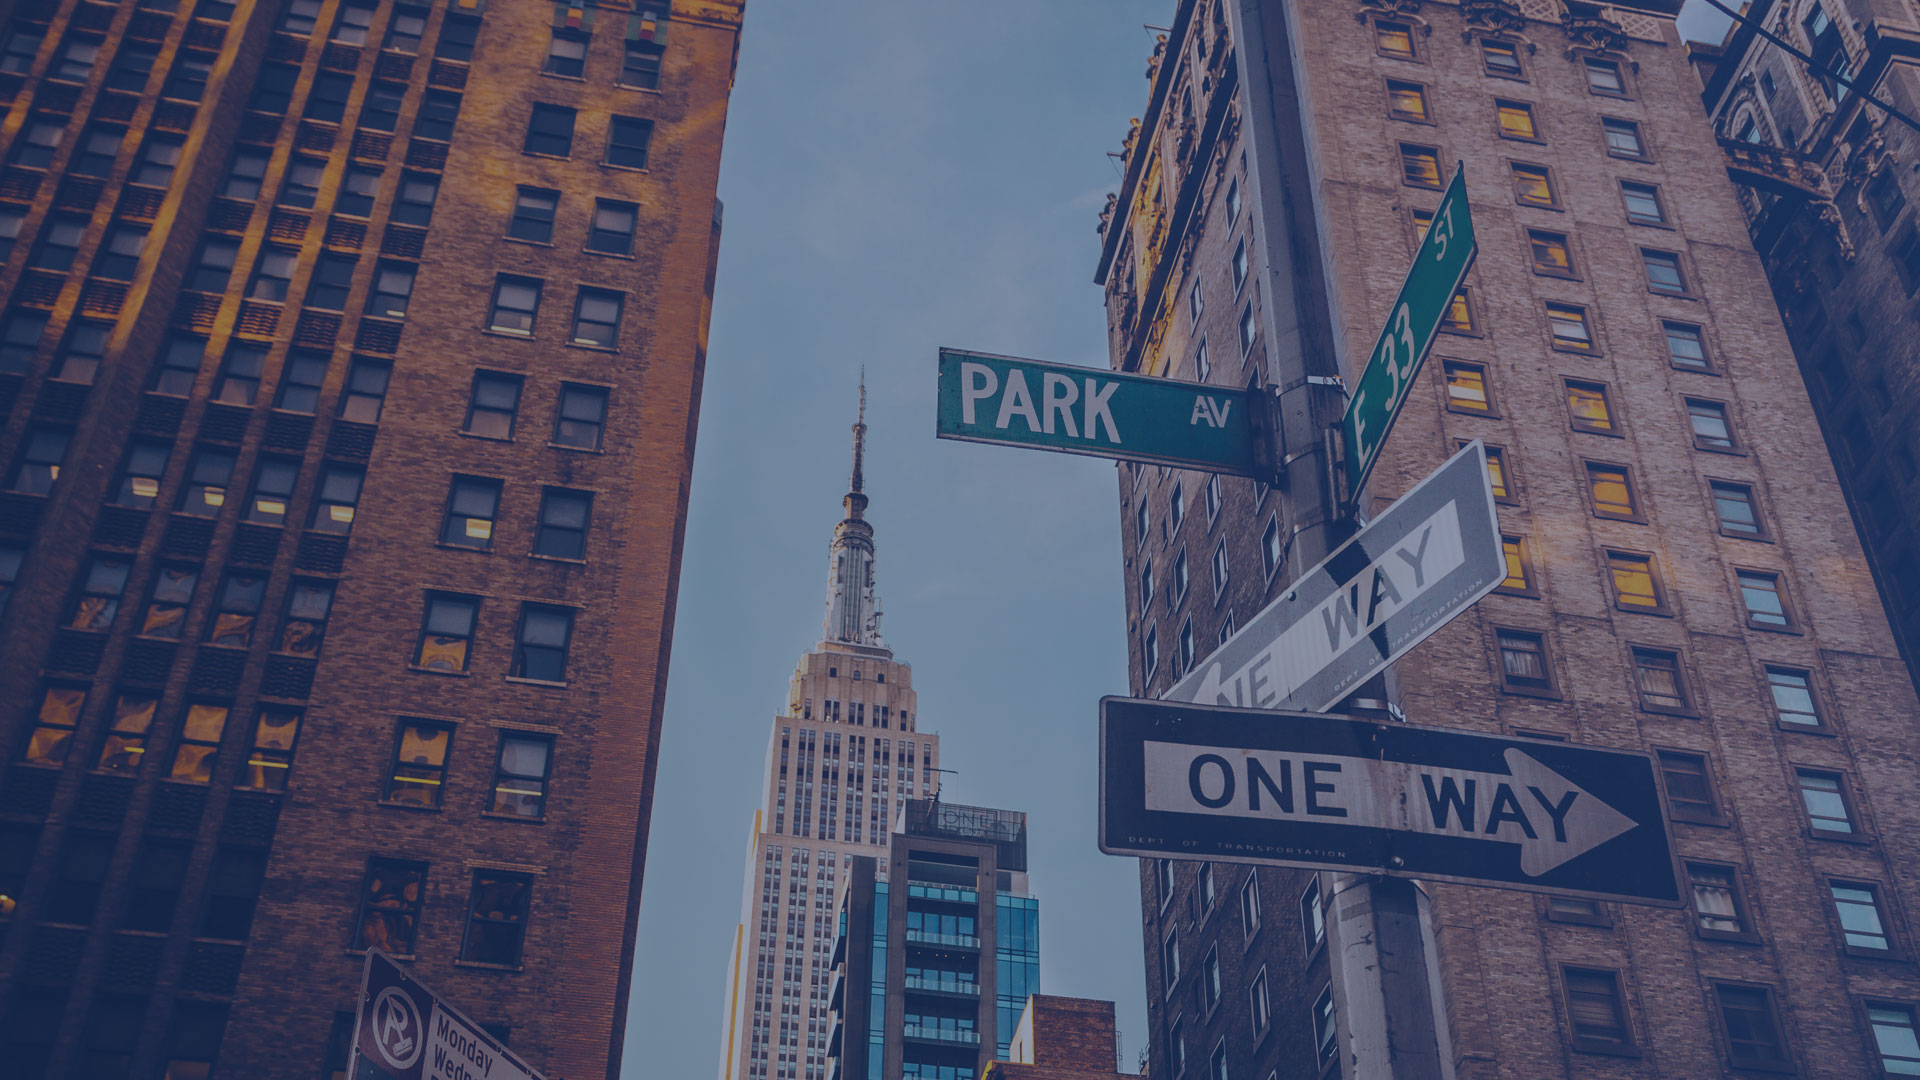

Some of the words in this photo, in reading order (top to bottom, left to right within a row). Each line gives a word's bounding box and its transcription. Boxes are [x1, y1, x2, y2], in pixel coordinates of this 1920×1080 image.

[1353, 389, 1371, 472] E
[1380, 302, 1415, 412] 33
[1434, 198, 1456, 261] ST
[961, 362, 1121, 444] PARK
[1190, 395, 1232, 428] AV
[1321, 525, 1433, 653] WAY
[1334, 671, 1358, 691] DEPT
[1391, 579, 1483, 649] TRANSPORTATION
[1188, 753, 1348, 818] ONE
[1420, 774, 1579, 843] WAY
[1128, 836, 1165, 846] DEPT
[1182, 840, 1199, 848] OF
[1217, 842, 1346, 858] TRANSPORTATION
[437, 1014, 493, 1078] Monday
